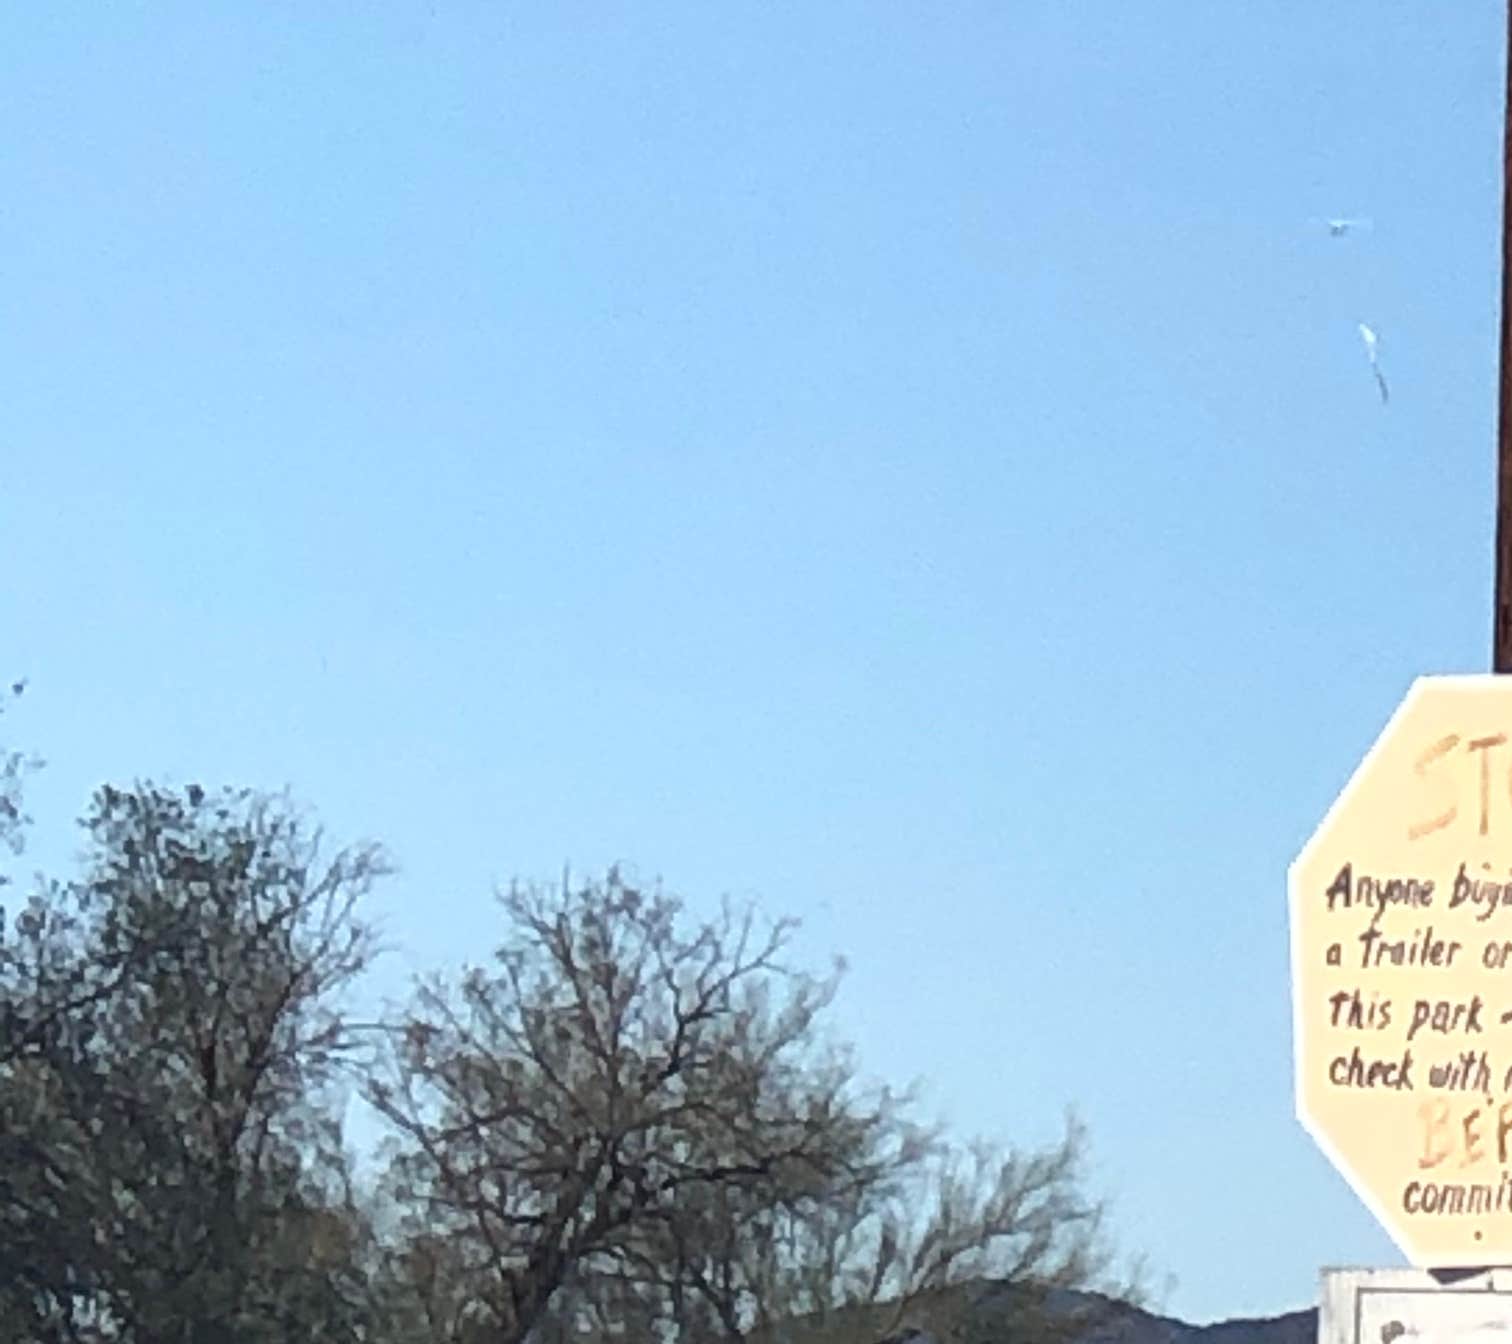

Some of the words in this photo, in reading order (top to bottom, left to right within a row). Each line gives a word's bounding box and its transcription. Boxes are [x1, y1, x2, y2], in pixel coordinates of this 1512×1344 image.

[1325, 862, 1435, 923] Anyone
[1325, 942, 1342, 967] a
[1406, 994, 1483, 1041] park
[1328, 1046, 1413, 1090] check
[1428, 1050, 1491, 1093] with
